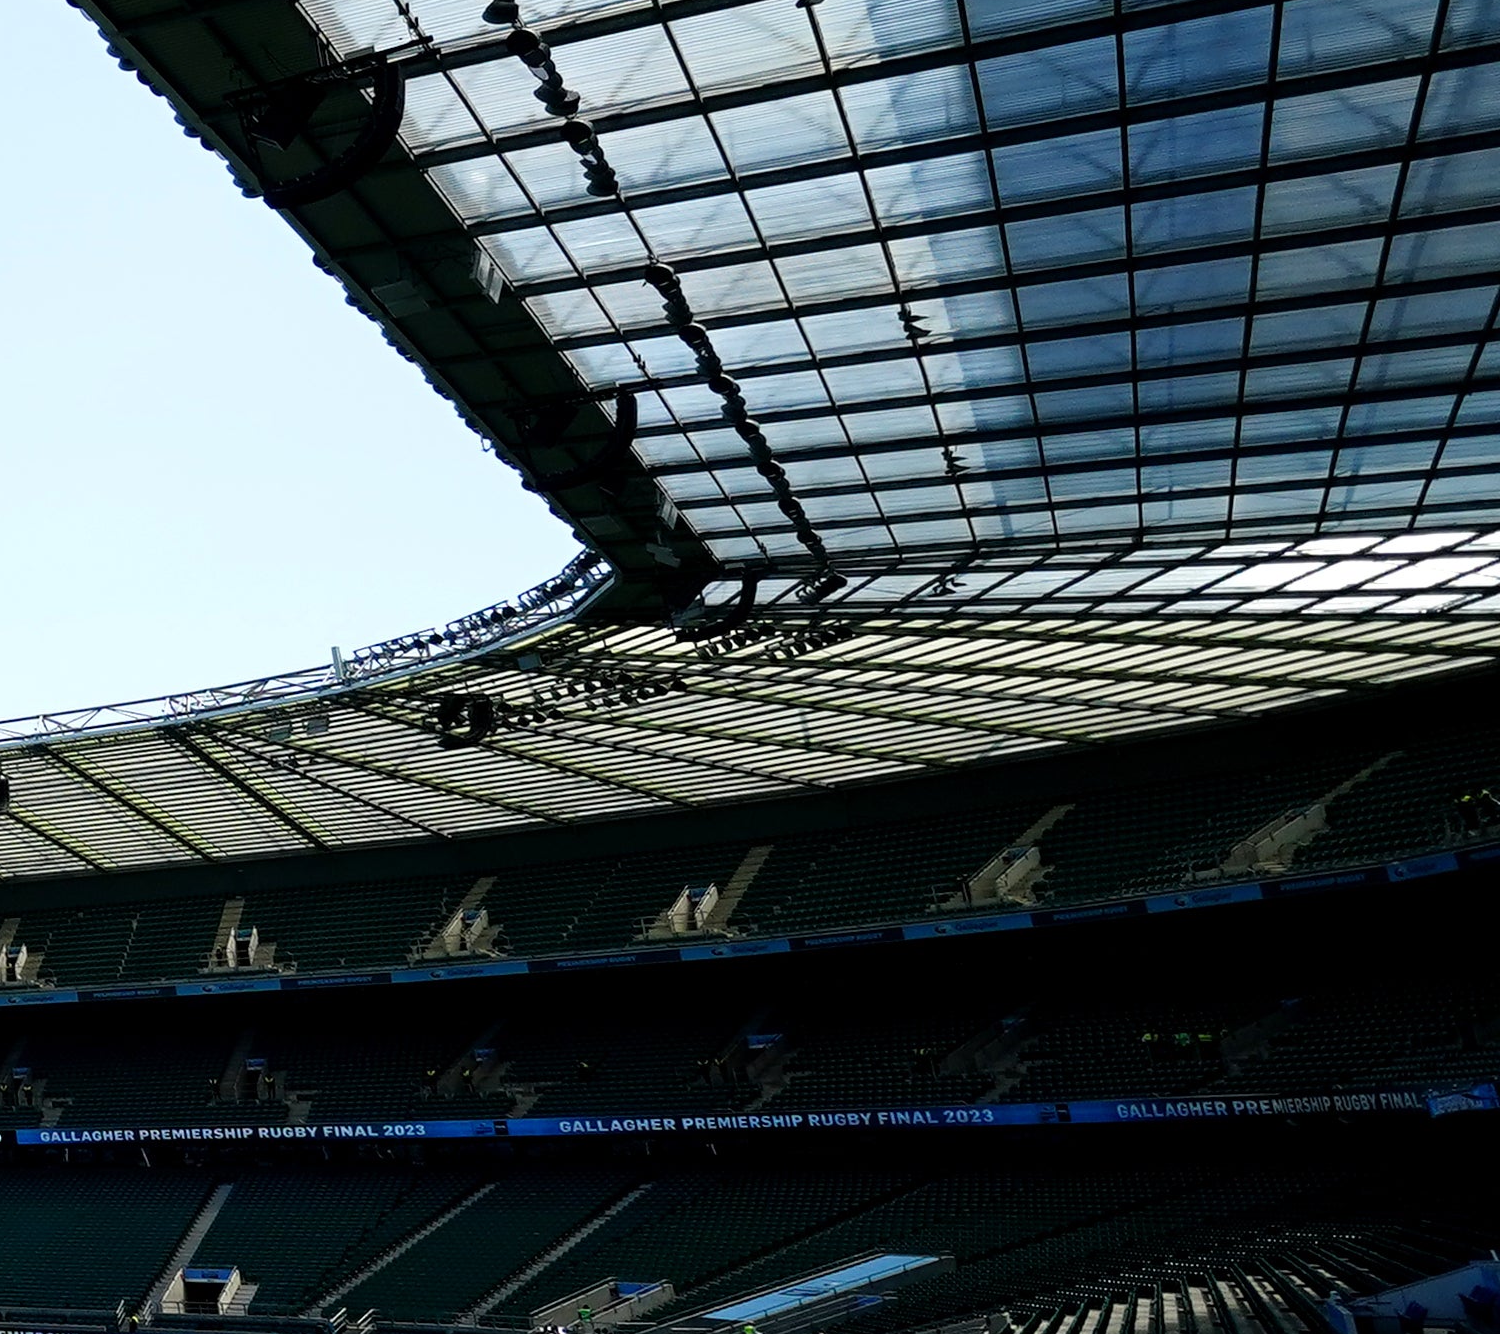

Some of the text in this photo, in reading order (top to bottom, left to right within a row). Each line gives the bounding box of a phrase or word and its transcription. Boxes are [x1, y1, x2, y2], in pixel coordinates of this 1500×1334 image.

[1117, 1100, 1226, 1119] GALLAGHER
[1233, 1094, 1331, 1115] PREMIERSHIP
[1333, 1093, 1376, 1113] RUGBY
[1380, 1091, 1423, 1110] FINAL
[41, 1124, 426, 1143] GALLAGHER PREMIERSHIP RUGBY FINAL 2023
[560, 1109, 995, 1134] GALLAGHER PREMIERSHIP RUGBY FINAL 2023
